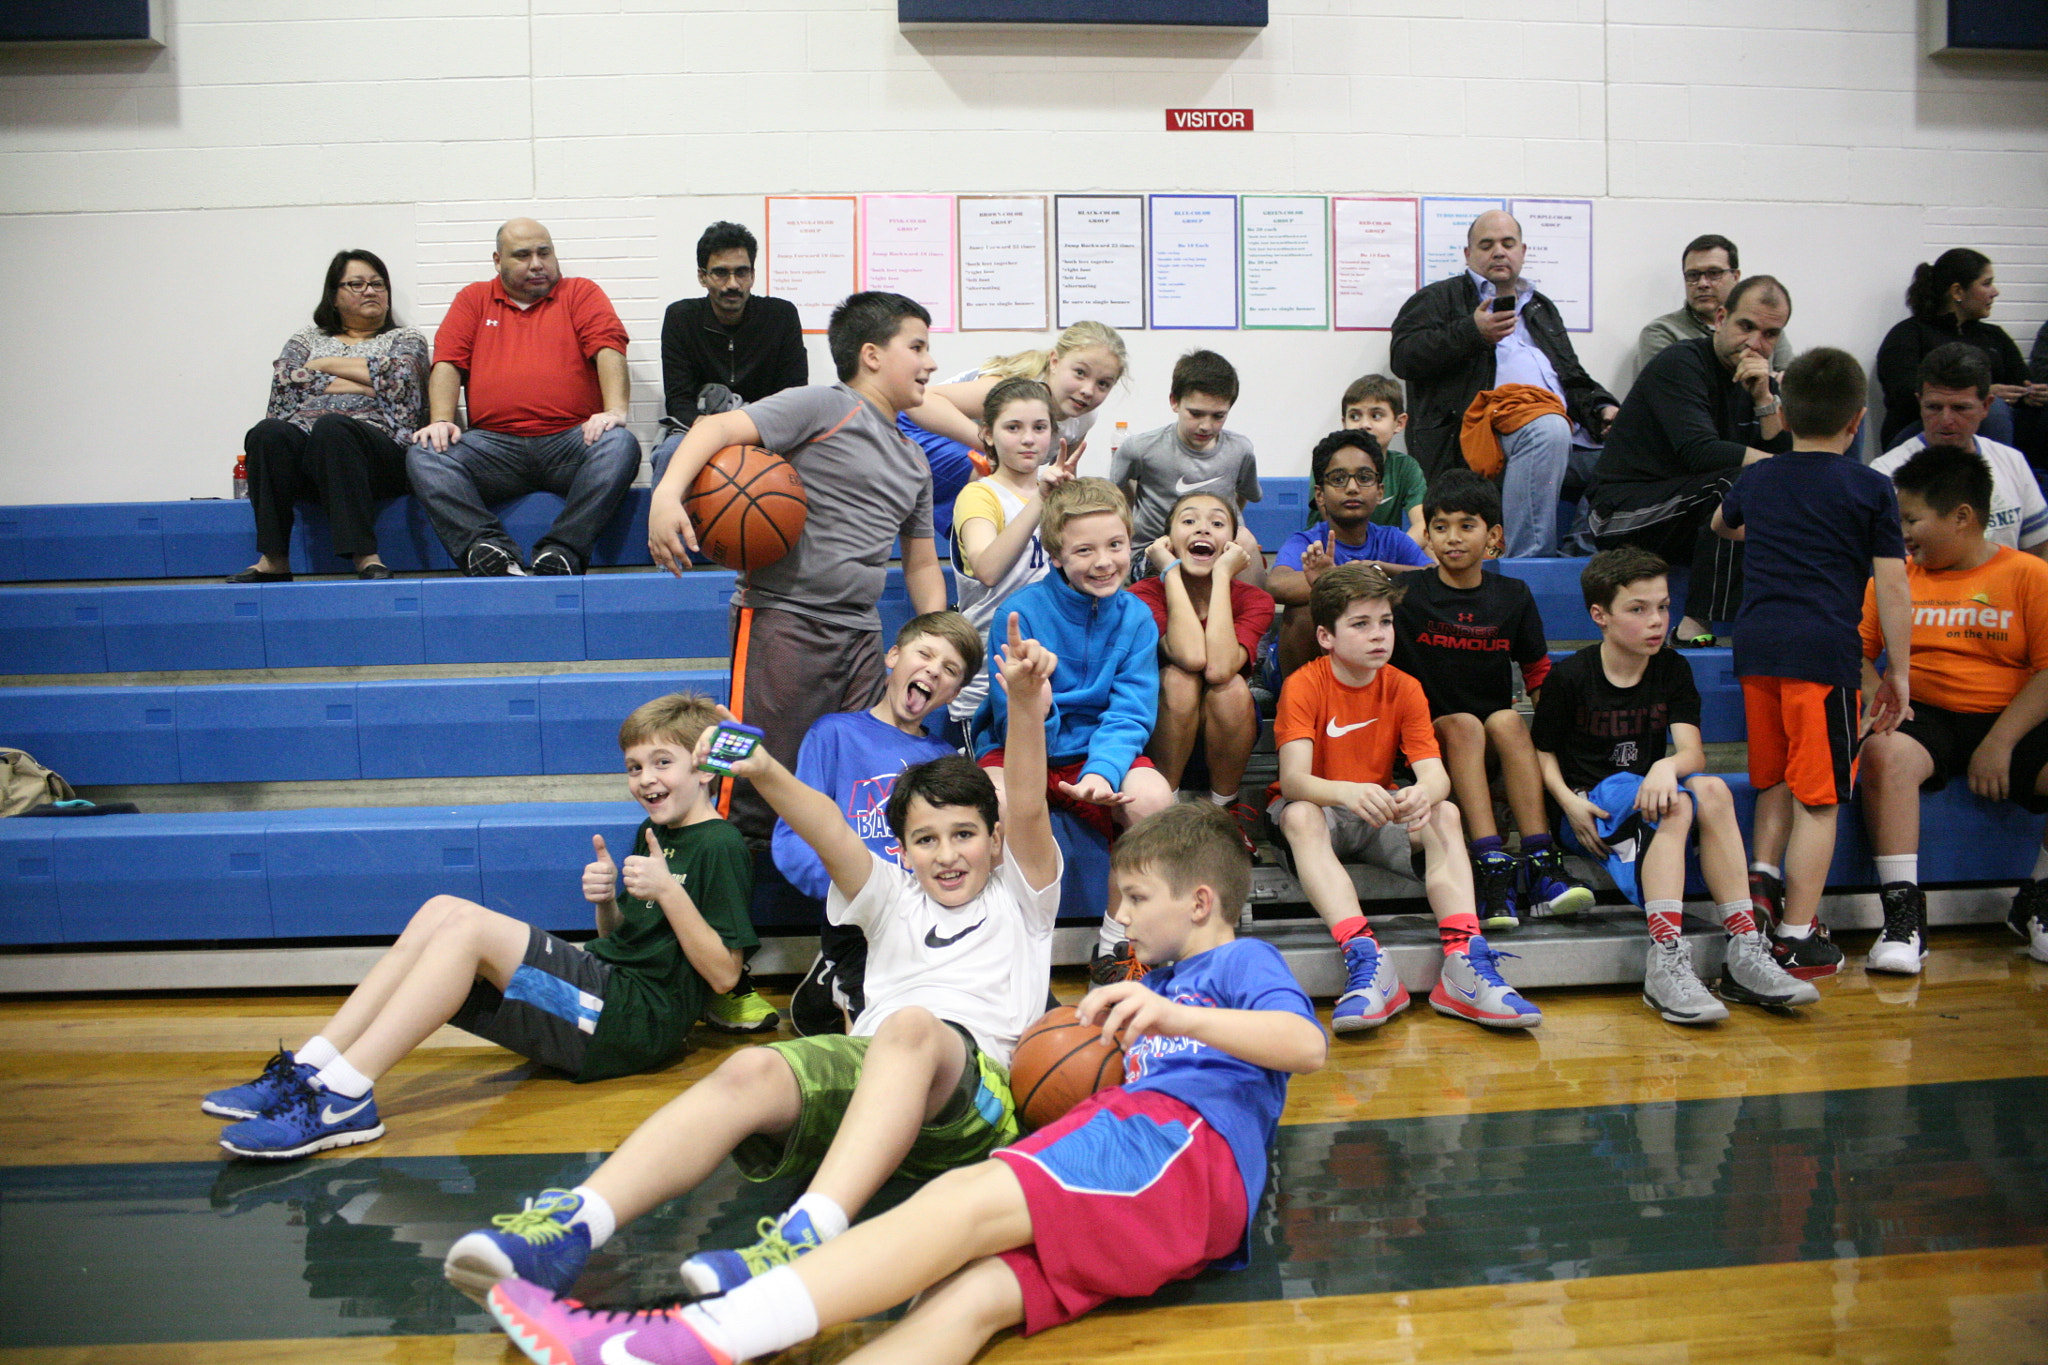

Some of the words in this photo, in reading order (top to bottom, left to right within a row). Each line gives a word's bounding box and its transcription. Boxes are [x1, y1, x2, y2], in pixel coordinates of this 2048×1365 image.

[1174, 112, 1245, 128] VISITOR
[1911, 608, 2014, 629] mmer
[1428, 621, 1499, 638] UNDER
[1965, 630, 1983, 639] the
[1987, 632, 2009, 642] Hill
[1416, 633, 1511, 651] ARMOUR
